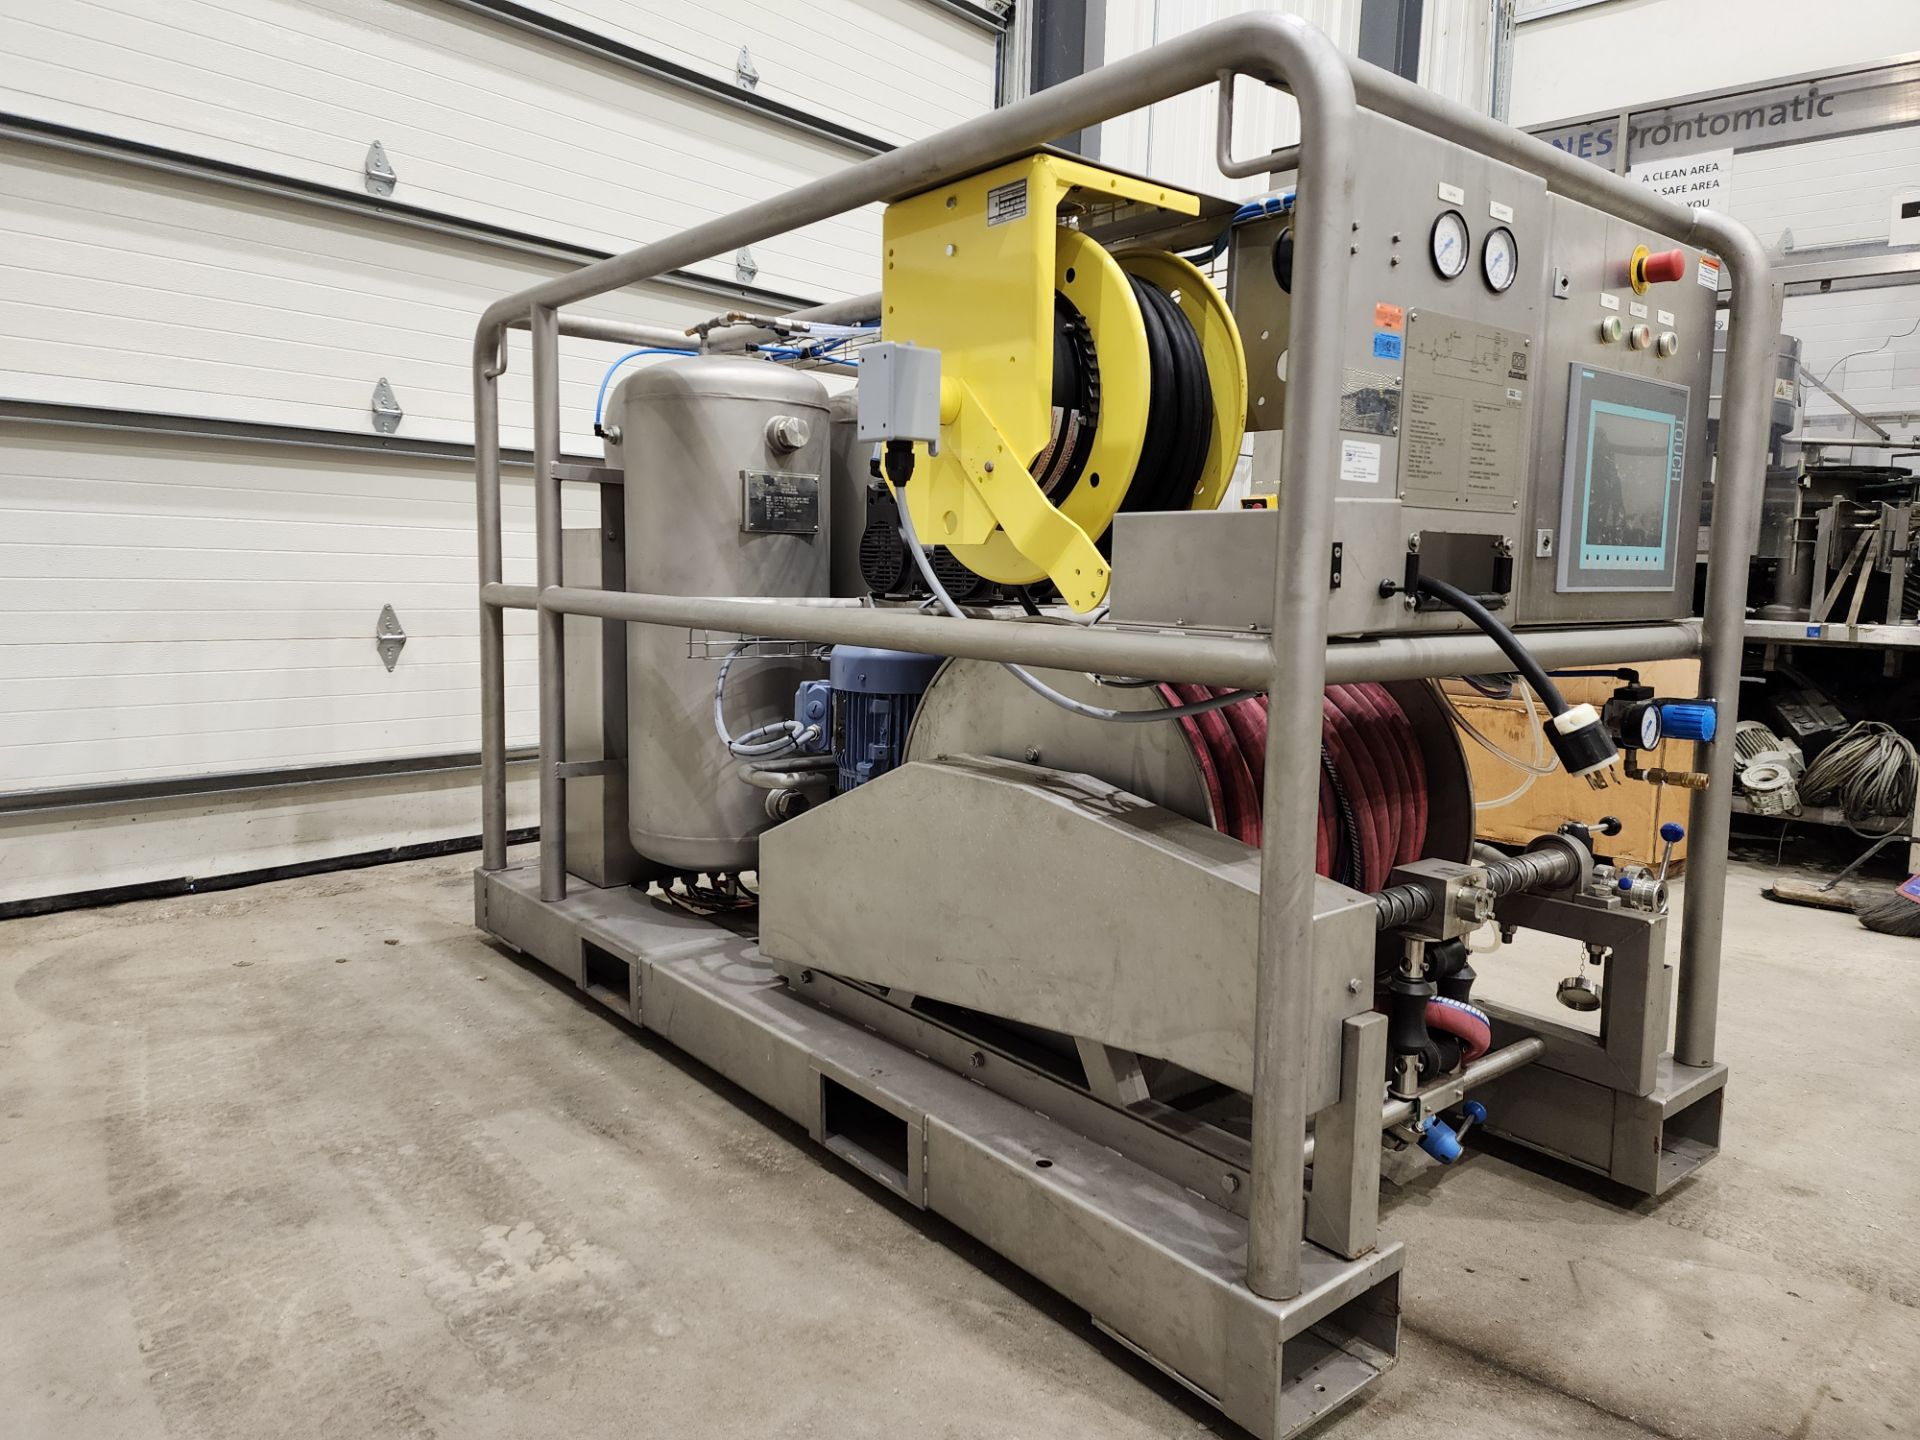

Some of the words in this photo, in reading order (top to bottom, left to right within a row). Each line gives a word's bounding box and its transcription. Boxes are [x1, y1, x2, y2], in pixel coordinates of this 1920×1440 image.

[1642, 174, 1650, 183] A
[1652, 168, 1687, 181] CLEAN
[1690, 162, 1719, 176] AREA
[1661, 184, 1687, 196] SAFE
[1690, 179, 1720, 192] AREA
[1671, 416, 1685, 481] TOUCH
